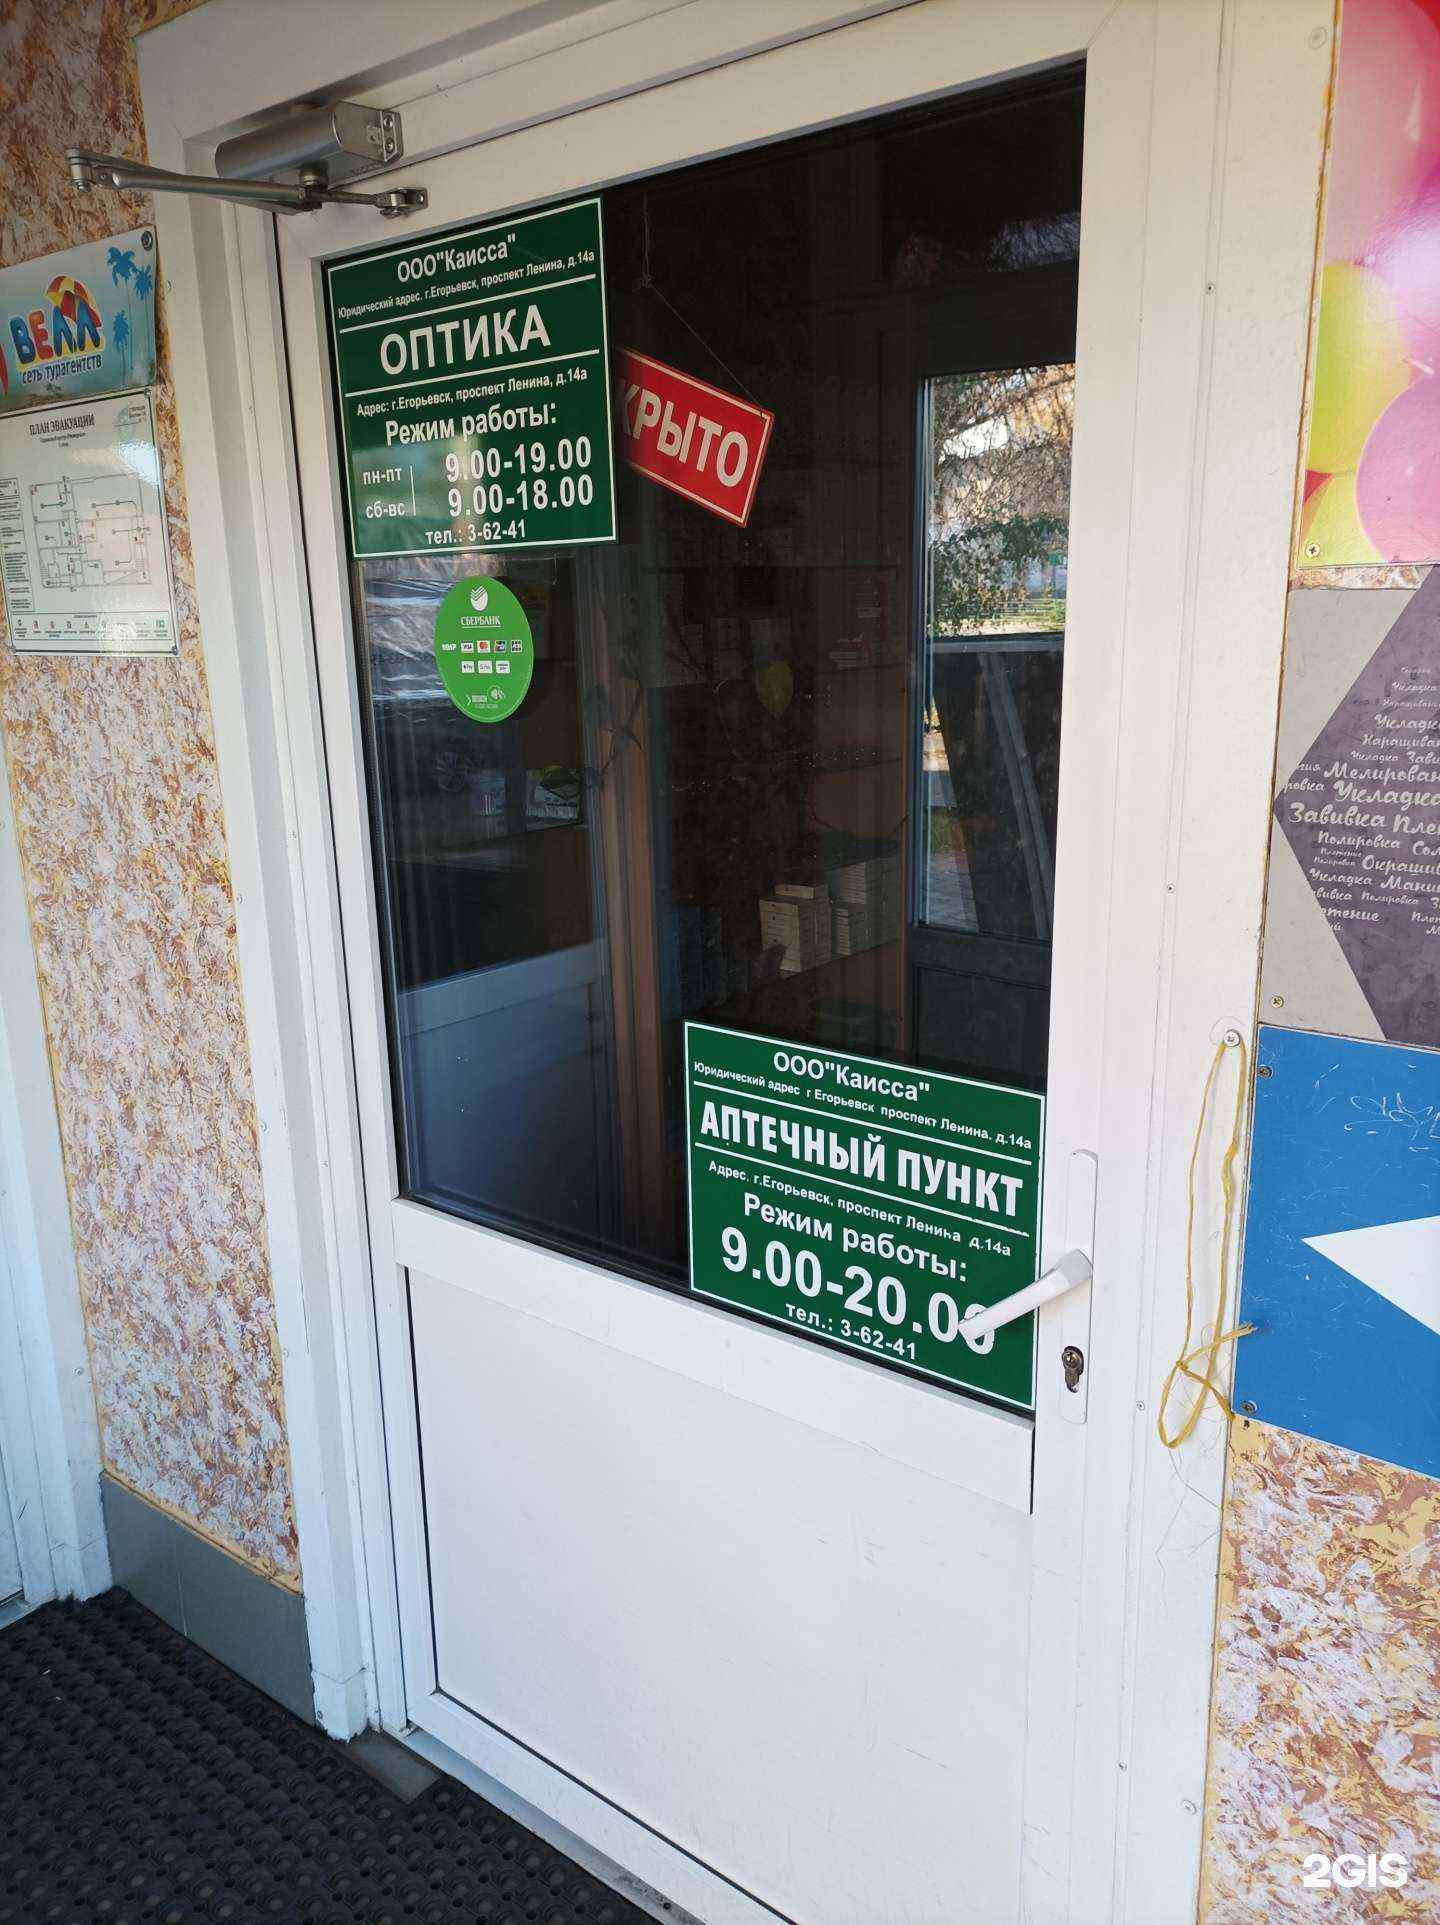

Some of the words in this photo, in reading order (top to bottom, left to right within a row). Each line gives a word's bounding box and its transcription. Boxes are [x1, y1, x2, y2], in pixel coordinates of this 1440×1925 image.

[397, 233, 516, 282] ООО"Каисса"
[338, 296, 394, 319] Юридический
[424, 279, 479, 299] г.Егорьевск,
[481, 268, 524, 287] проспект
[526, 259, 566, 277] Ленина,
[567, 251, 595, 269] д.14а
[380, 304, 551, 375] ОПТИКА
[22, 367, 42, 384] сеть
[45, 355, 102, 381] турагентств
[357, 403, 390, 417] Адрес:
[391, 393, 454, 412] г.Егорьевск,
[456, 385, 505, 402] проспект
[508, 377, 553, 393] Ленина,
[555, 367, 588, 387] д.14а
[29, 422, 50, 436] ПЛАН
[49, 413, 95, 433] ЭВАКУАЦИИ
[386, 418, 455, 446] Режим
[461, 402, 557, 442] работы:
[362, 467, 403, 485] пн-пт
[445, 436, 592, 483] 9.00-19.00
[365, 501, 405, 519] сб-вс
[448, 474, 594, 517] 9.00-18.00
[425, 528, 463, 545] тел.:
[468, 519, 526, 542] 3-62-41
[460, 615, 501, 626] СБЕРБАНК
[1374, 713, 1440, 733] Укладк
[1289, 802, 1388, 828] Завивка
[1318, 830, 1400, 850] Полировка
[1309, 868, 1373, 887] Укладка
[773, 1051, 930, 1102] ООО"Каисса"
[694, 1061, 765, 1087] Юридический
[880, 1106, 937, 1127] проспект
[995, 1134, 1032, 1149] д.14а
[700, 1101, 886, 1182] АПТЕЧНЫЙ
[898, 1149, 1023, 1217] ПУНКТ
[743, 1192, 833, 1242] Режим
[843, 1227, 967, 1282] работы:
[838, 1198, 902, 1225] проспект
[968, 1236, 1011, 1257] д.14а
[785, 1303, 833, 1331] тел.:
[840, 1318, 916, 1360] 3-62-41
